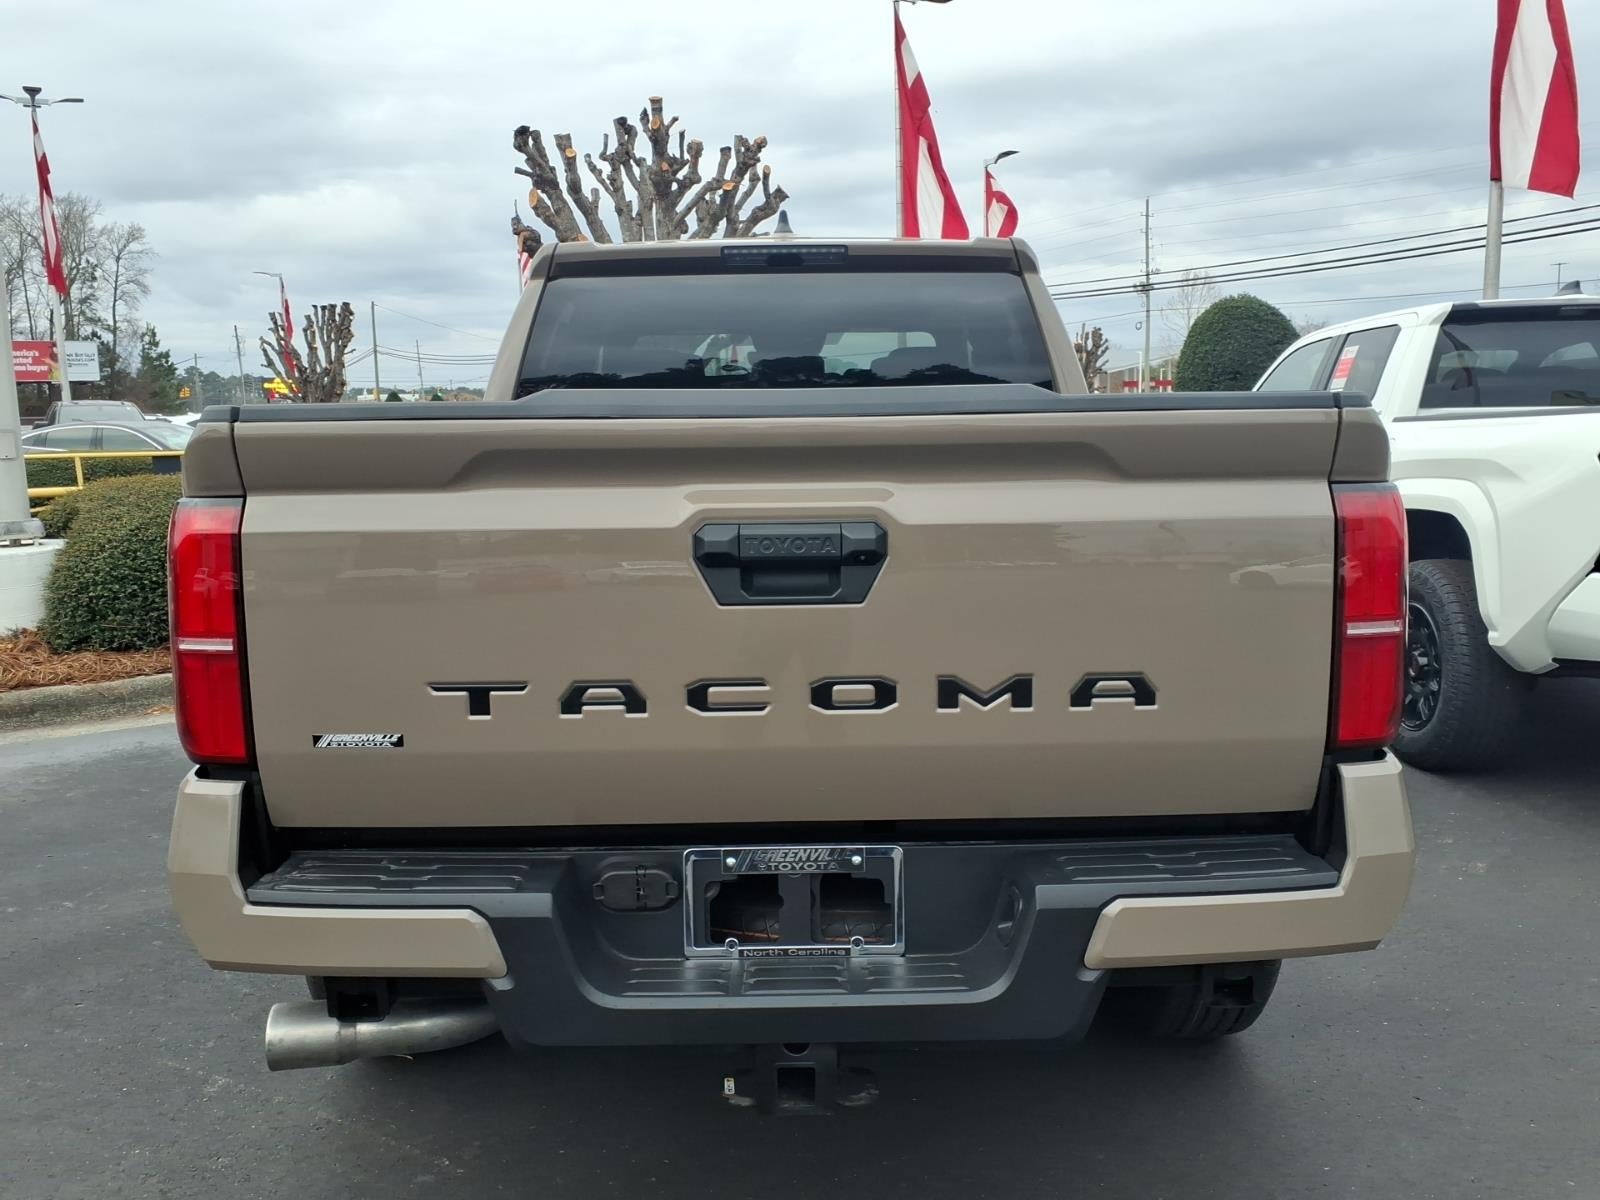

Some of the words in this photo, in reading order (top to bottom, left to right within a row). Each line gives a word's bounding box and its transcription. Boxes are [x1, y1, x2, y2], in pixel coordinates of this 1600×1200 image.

[26, 364, 49, 373] buyer
[744, 536, 837, 554] TOYOTA
[426, 671, 1159, 720] TACOMA
[331, 734, 402, 742] GREENVILLE
[753, 848, 856, 862] GREENVILLE
[768, 861, 840, 871] TOYOTA
[743, 949, 784, 957] North
[788, 948, 846, 956] Carolina
